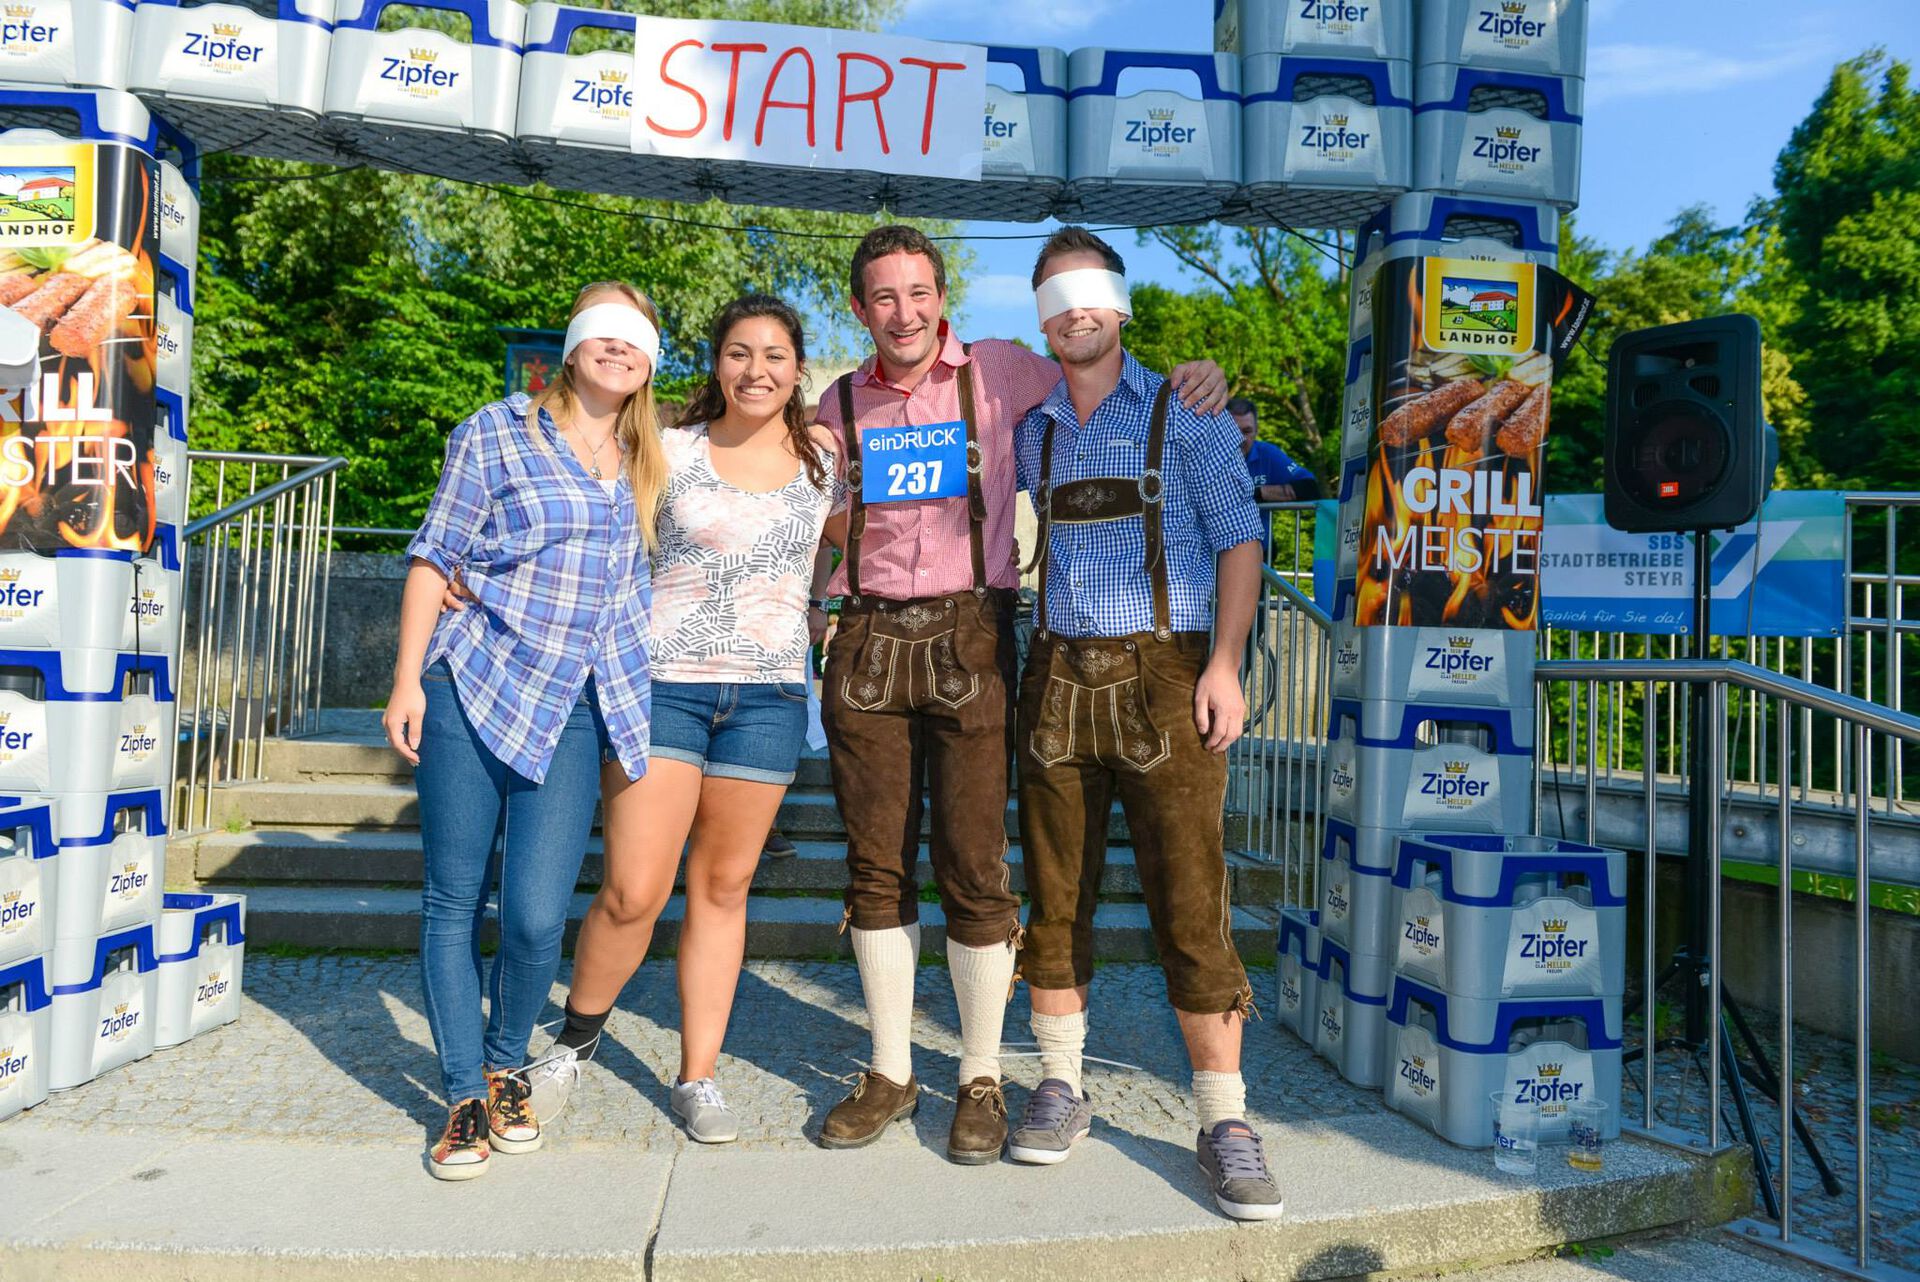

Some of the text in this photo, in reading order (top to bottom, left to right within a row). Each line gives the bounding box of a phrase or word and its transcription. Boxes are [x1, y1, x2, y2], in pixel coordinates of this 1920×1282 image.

[1300, 0, 1369, 24] Zipfer
[1478, 11, 1546, 38] Zipfer
[2, 19, 59, 44] pfer
[182, 32, 263, 62] Zipfer
[380, 57, 460, 87] Zipfer
[572, 80, 633, 108] Zipfe
[646, 38, 967, 156] START
[983, 115, 1018, 138] fer
[1125, 120, 1196, 147] Zipfer
[1301, 125, 1370, 152] Zipfer
[1473, 135, 1541, 163] Zipfer
[1439, 331, 1518, 345] LANDHOF
[1, 435, 138, 490] STER
[888, 460, 943, 496] 237
[1403, 467, 1541, 517] GRILL
[1648, 535, 1685, 550] SBS
[1541, 553, 1684, 568] STADTBETRIEBE
[1624, 571, 1683, 586] STEYR
[0, 582, 44, 606] fer
[130, 597, 164, 618] Zipfer
[1594, 609, 1617, 622] für
[1624, 611, 1647, 623] Sie
[1654, 611, 1685, 624] da!
[1425, 647, 1494, 674] Zipfer
[120, 734, 157, 755] Zipfer
[1421, 772, 1490, 799] Zipfer
[111, 873, 148, 893] Zipfer
[1405, 921, 1440, 949] Zipfer
[1520, 933, 1588, 963] Zipfer
[198, 980, 229, 1002] Zipfer
[101, 1011, 140, 1038] Zipfer
[0, 1055, 28, 1079] fer
[1400, 1059, 1436, 1092] Zipfer
[1515, 1077, 1584, 1106] Zipfer
